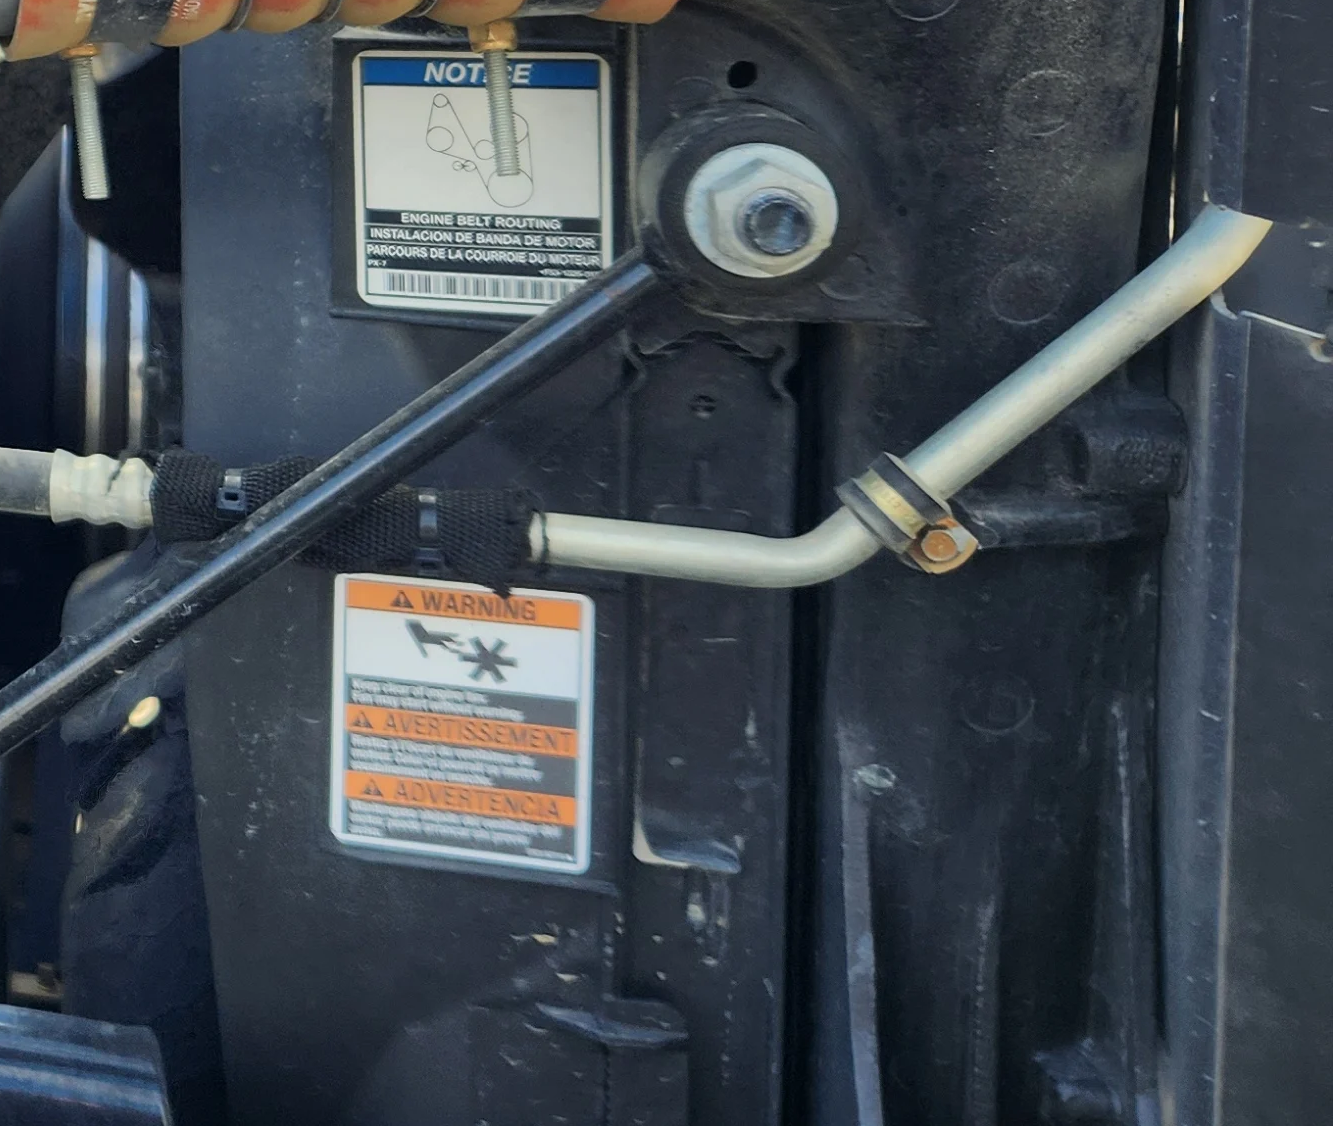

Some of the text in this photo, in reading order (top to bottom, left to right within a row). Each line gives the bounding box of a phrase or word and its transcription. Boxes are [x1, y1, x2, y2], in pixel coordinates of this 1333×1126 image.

[423, 61, 533, 85] NOTE
[400, 212, 562, 230] ENGINE BELT ROUTING
[369, 227, 597, 249] INSTALACION DE BANDA DE MOTOR
[366, 244, 601, 267] PARCOURS DE LA COURROIE DU MOTEUR
[421, 589, 536, 622] WARNING
[383, 713, 573, 751] AVERTISSEMENT
[394, 781, 561, 819] ADVERTENCIA
